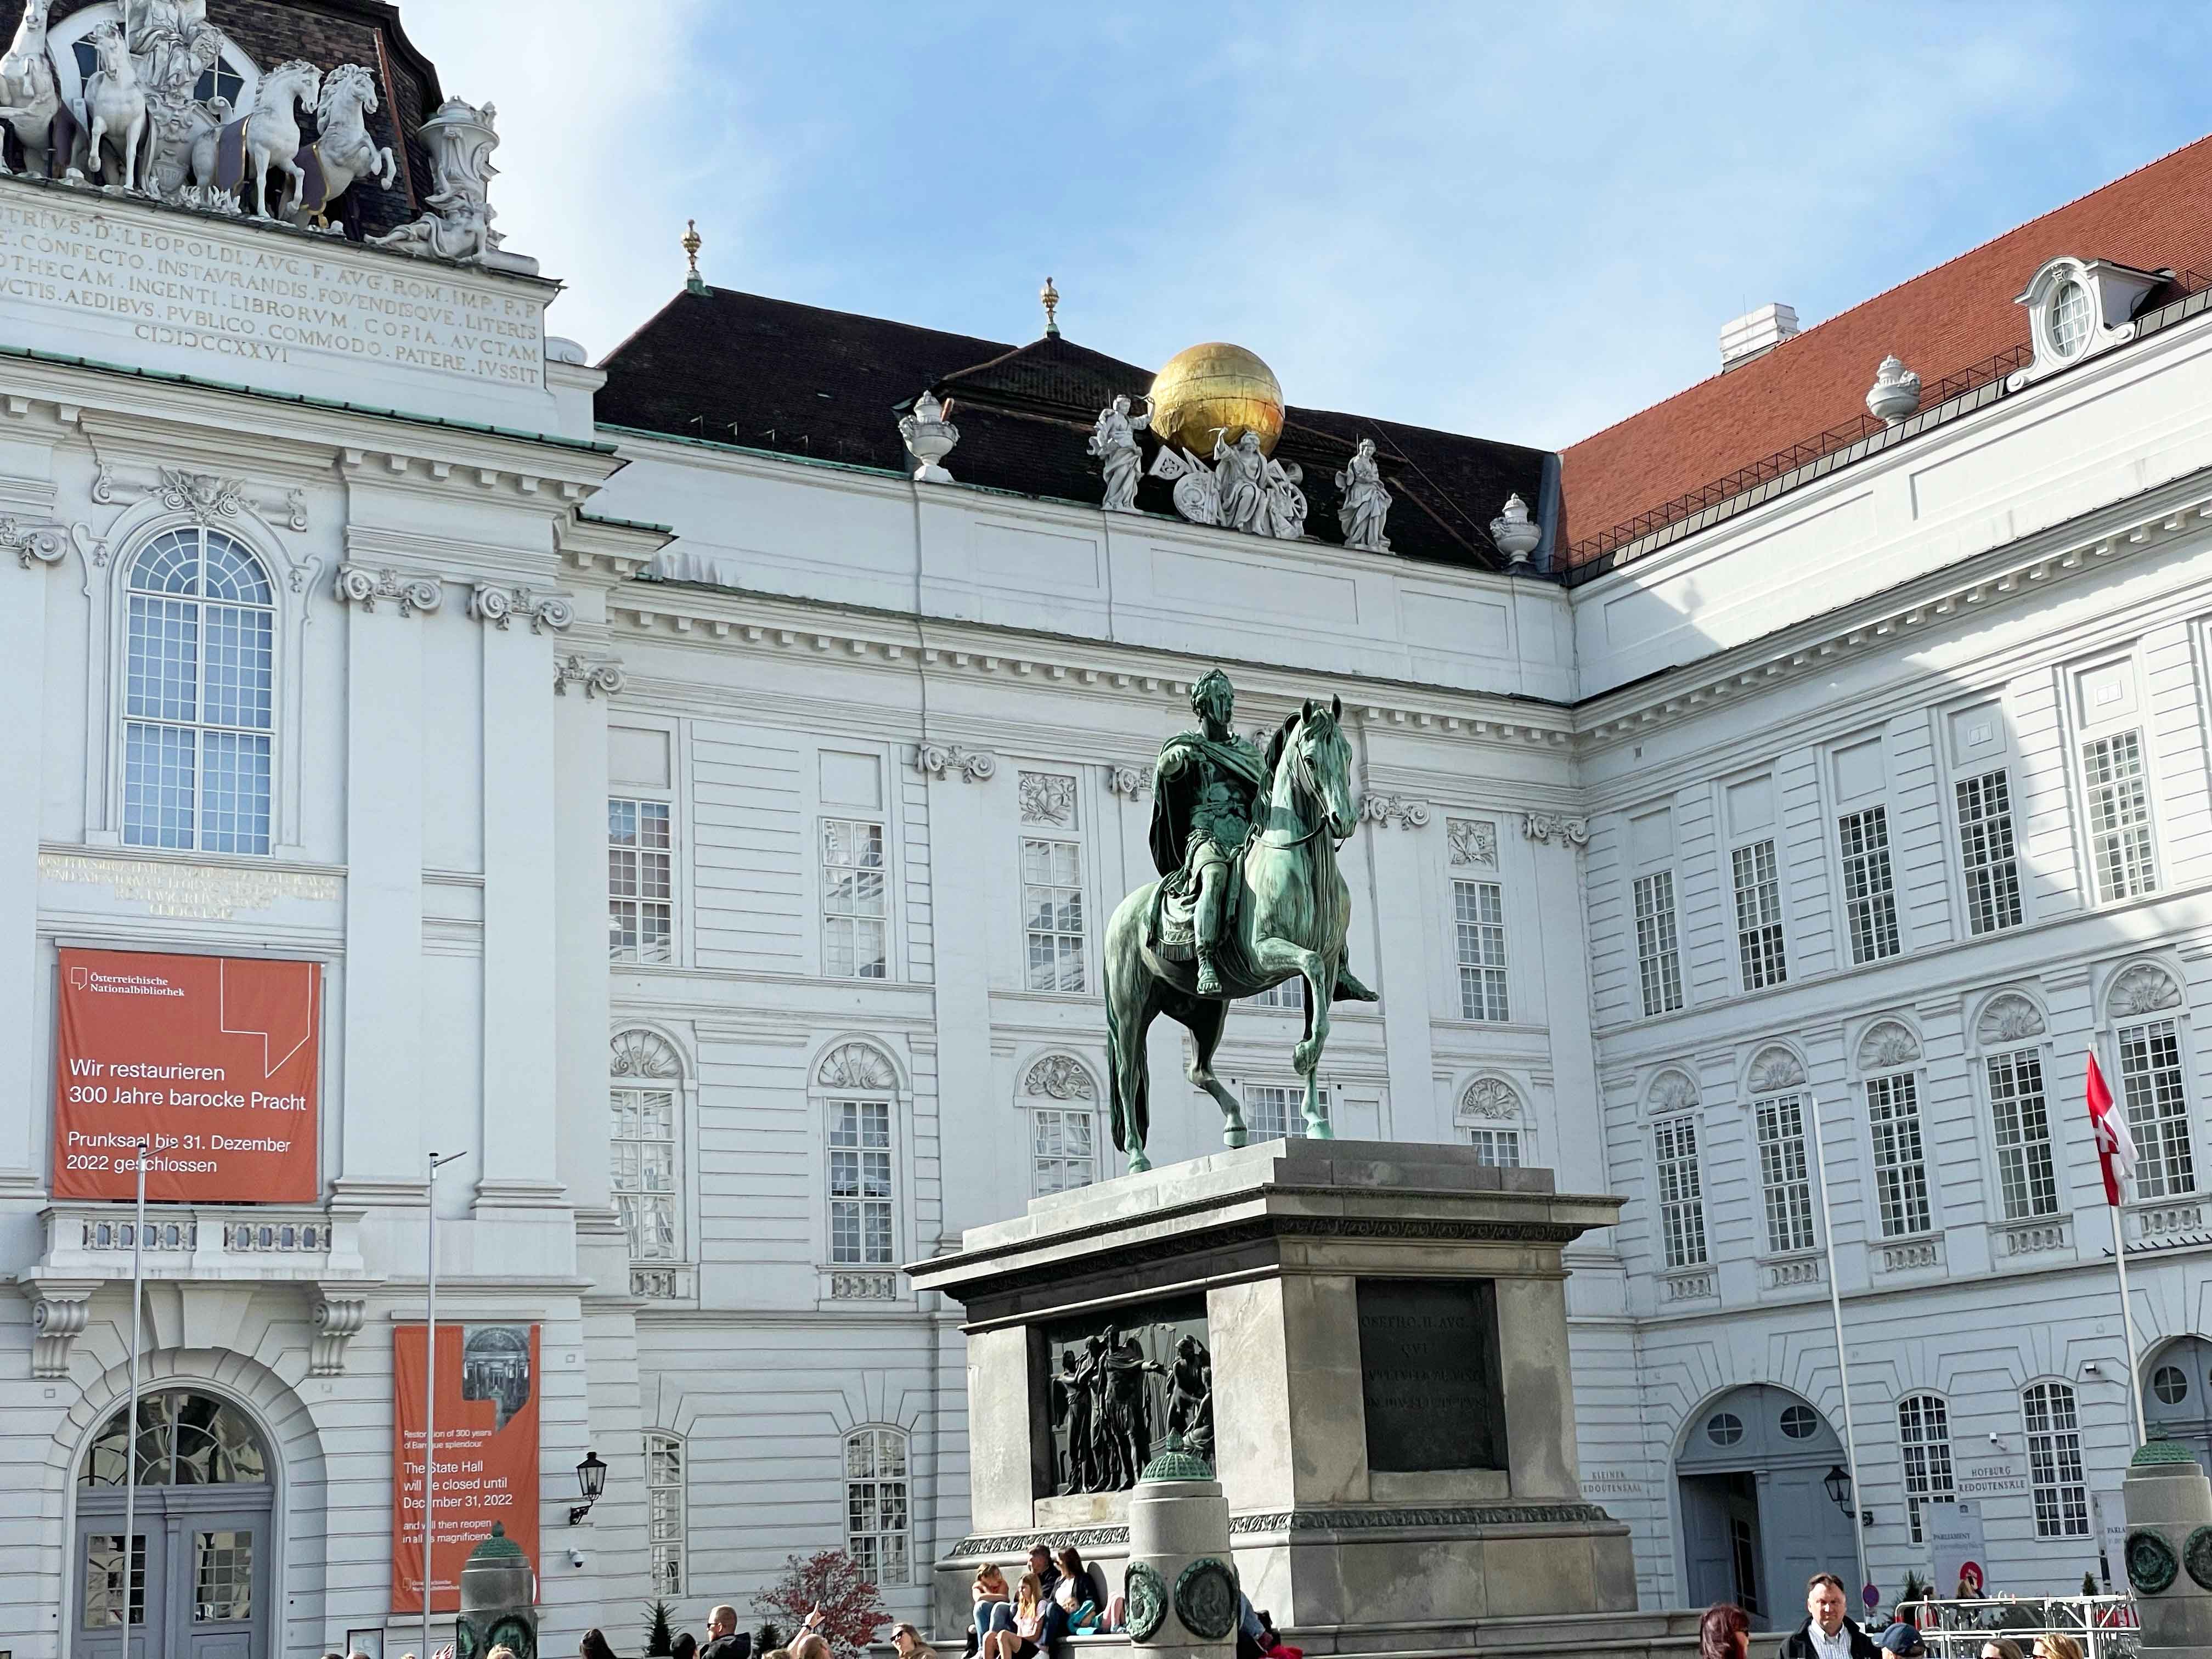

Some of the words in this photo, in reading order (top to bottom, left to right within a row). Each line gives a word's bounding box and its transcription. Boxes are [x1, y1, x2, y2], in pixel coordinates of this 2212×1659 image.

[0, 207, 80, 234] TRIVS
[125, 229, 242, 265] LEOPOLDI
[21, 234, 144, 269] CONFECTO
[157, 258, 307, 298] INSTAVRANDIS
[319, 288, 455, 325] FOVENDISQVE
[129, 276, 217, 306] INGENTI
[231, 294, 347, 329] LIBRORVM
[365, 319, 437, 345] COPIA
[452, 334, 538, 362] AVCTAM
[64, 289, 154, 317] AEDIBVS
[167, 306, 255, 334] PVBLICO
[269, 324, 381, 356] COMMODO
[396, 345, 465, 371] PATERE
[478, 359, 539, 383] IVSSIT
[91, 972, 168, 985] Österreichische
[91, 984, 184, 997] Nationalbibliothek
[70, 1058, 104, 1076] Wir
[110, 1063, 224, 1081] restaurieren
[69, 1086, 108, 1103] 300
[112, 1087, 163, 1105] Jahre
[170, 1088, 245, 1108] barocke
[251, 1091, 306, 1110] Pracht
[68, 1131, 150, 1148] Prunksaal
[155, 1133, 178, 1149] bis
[183, 1135, 205, 1149] 31.
[211, 1135, 291, 1152] Dezember
[66, 1155, 109, 1170] 2022
[471, 1430, 492, 1438] years
[412, 1442, 443, 1450] Barue
[403, 1462, 425, 1474] The
[432, 1462, 458, 1473] State
[462, 1460, 483, 1472] Hall
[1971, 1466, 2011, 1477] HOFBURG
[1592, 1470, 1624, 1480] KLEINER
[404, 1480, 421, 1491] will
[443, 1479, 480, 1490] closed
[484, 1477, 507, 1488] until
[1583, 1483, 1641, 1492] EDOUTENSAAL
[1959, 1480, 2025, 1492] REDOUTENSÄLE
[404, 1496, 462, 1508] Decmber
[465, 1496, 481, 1507] 31,
[484, 1494, 513, 1506] 2022
[404, 1521, 420, 1530] and
[421, 1521, 436, 1530] wll
[439, 1521, 458, 1529] then
[461, 1520, 492, 1530] reopen
[413, 1534, 422, 1543] all
[437, 1532, 493, 1544] magnificenc
